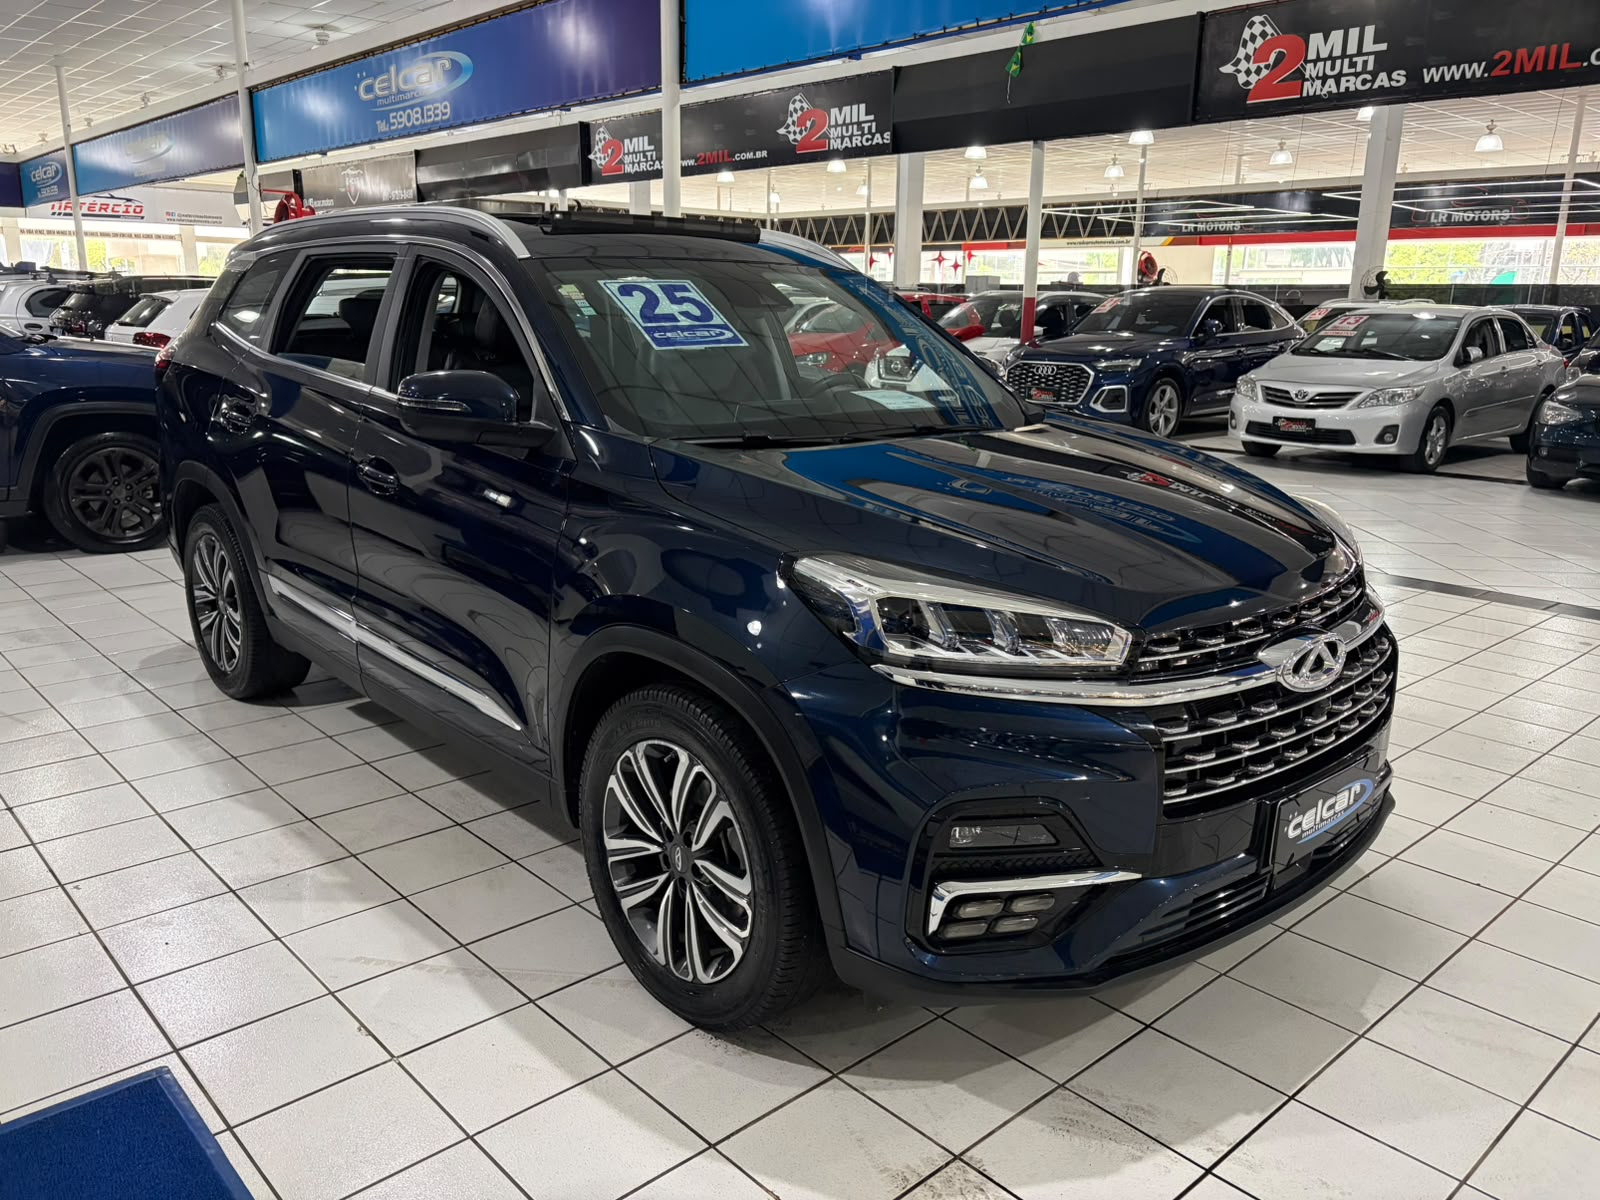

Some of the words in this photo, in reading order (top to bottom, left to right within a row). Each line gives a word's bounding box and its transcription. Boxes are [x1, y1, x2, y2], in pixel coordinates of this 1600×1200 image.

[1247, 34, 1306, 104] 2
[1307, 24, 1388, 61] MIL
[1305, 54, 1375, 79] MULTI
[359, 58, 452, 101] celcar
[1302, 70, 1407, 98] MARCAS
[389, 101, 450, 130] 5908.1339
[796, 108, 829, 154] 2
[830, 103, 875, 126] MIL
[830, 121, 876, 138] MULTI
[601, 139, 624, 176] 2
[624, 135, 655, 153] MIL
[829, 131, 891, 151] MARCAS
[624, 152, 656, 164] MULTI
[1430, 211, 1447, 223] LR
[1451, 208, 1511, 222] MOTORS
[617, 283, 714, 323] 25
[653, 329, 721, 340] celcar
[1287, 783, 1361, 839] celcar
[1301, 809, 1345, 838] multimarcas
